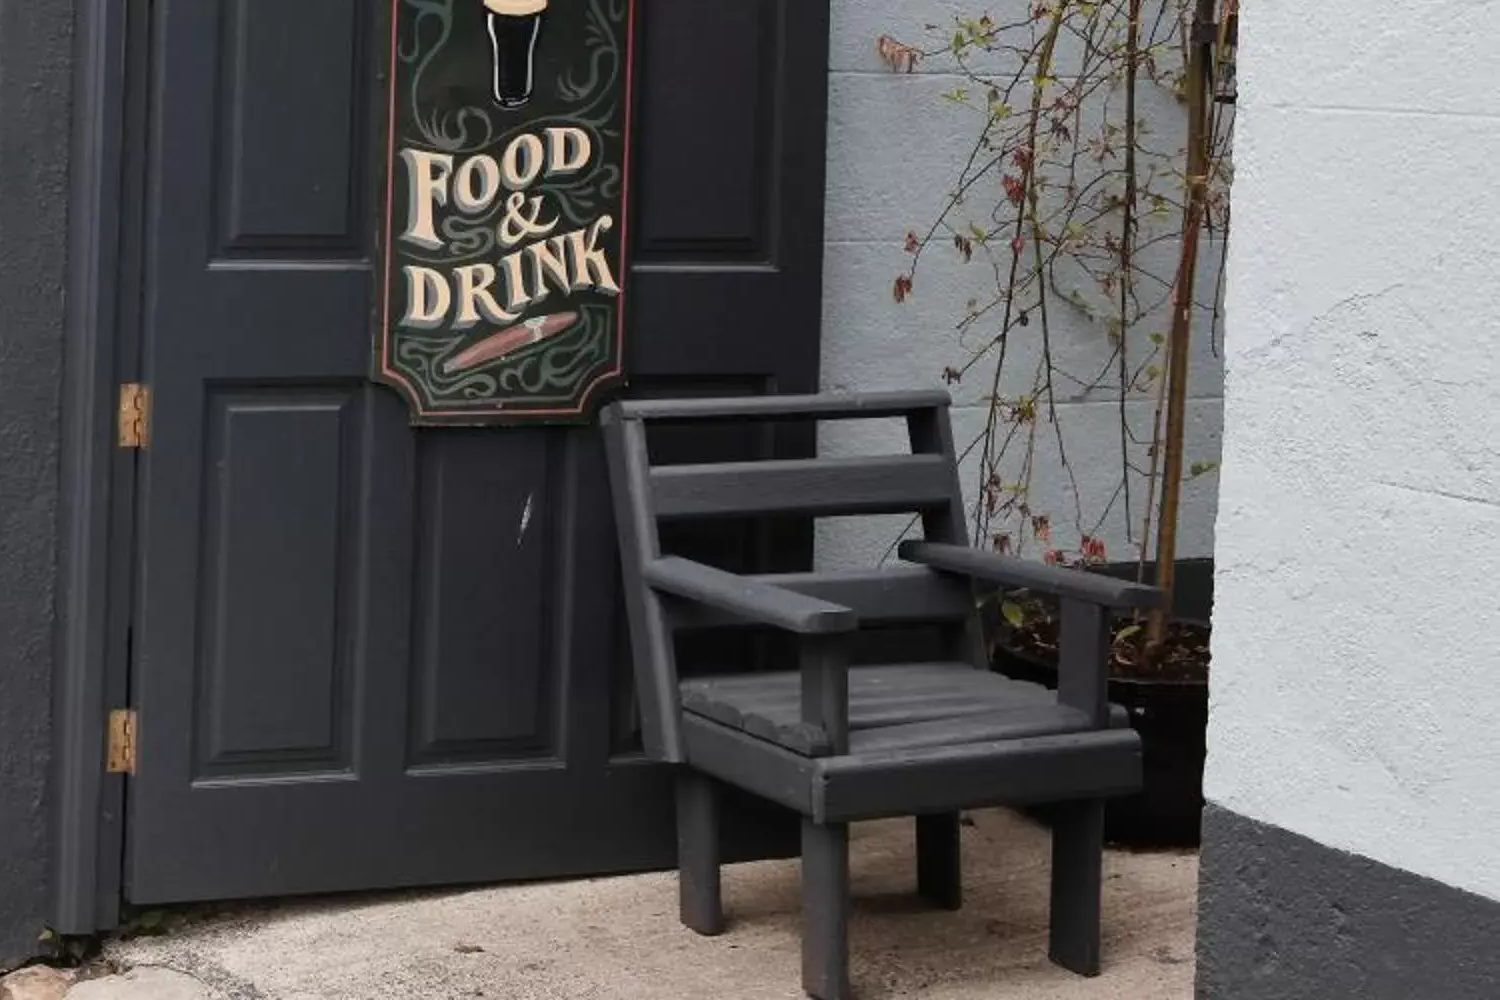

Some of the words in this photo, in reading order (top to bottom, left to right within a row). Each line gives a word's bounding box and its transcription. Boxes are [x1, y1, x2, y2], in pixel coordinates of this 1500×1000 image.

[399, 126, 592, 249] FOOD
[500, 190, 560, 248] &
[399, 214, 623, 330] DRINK
